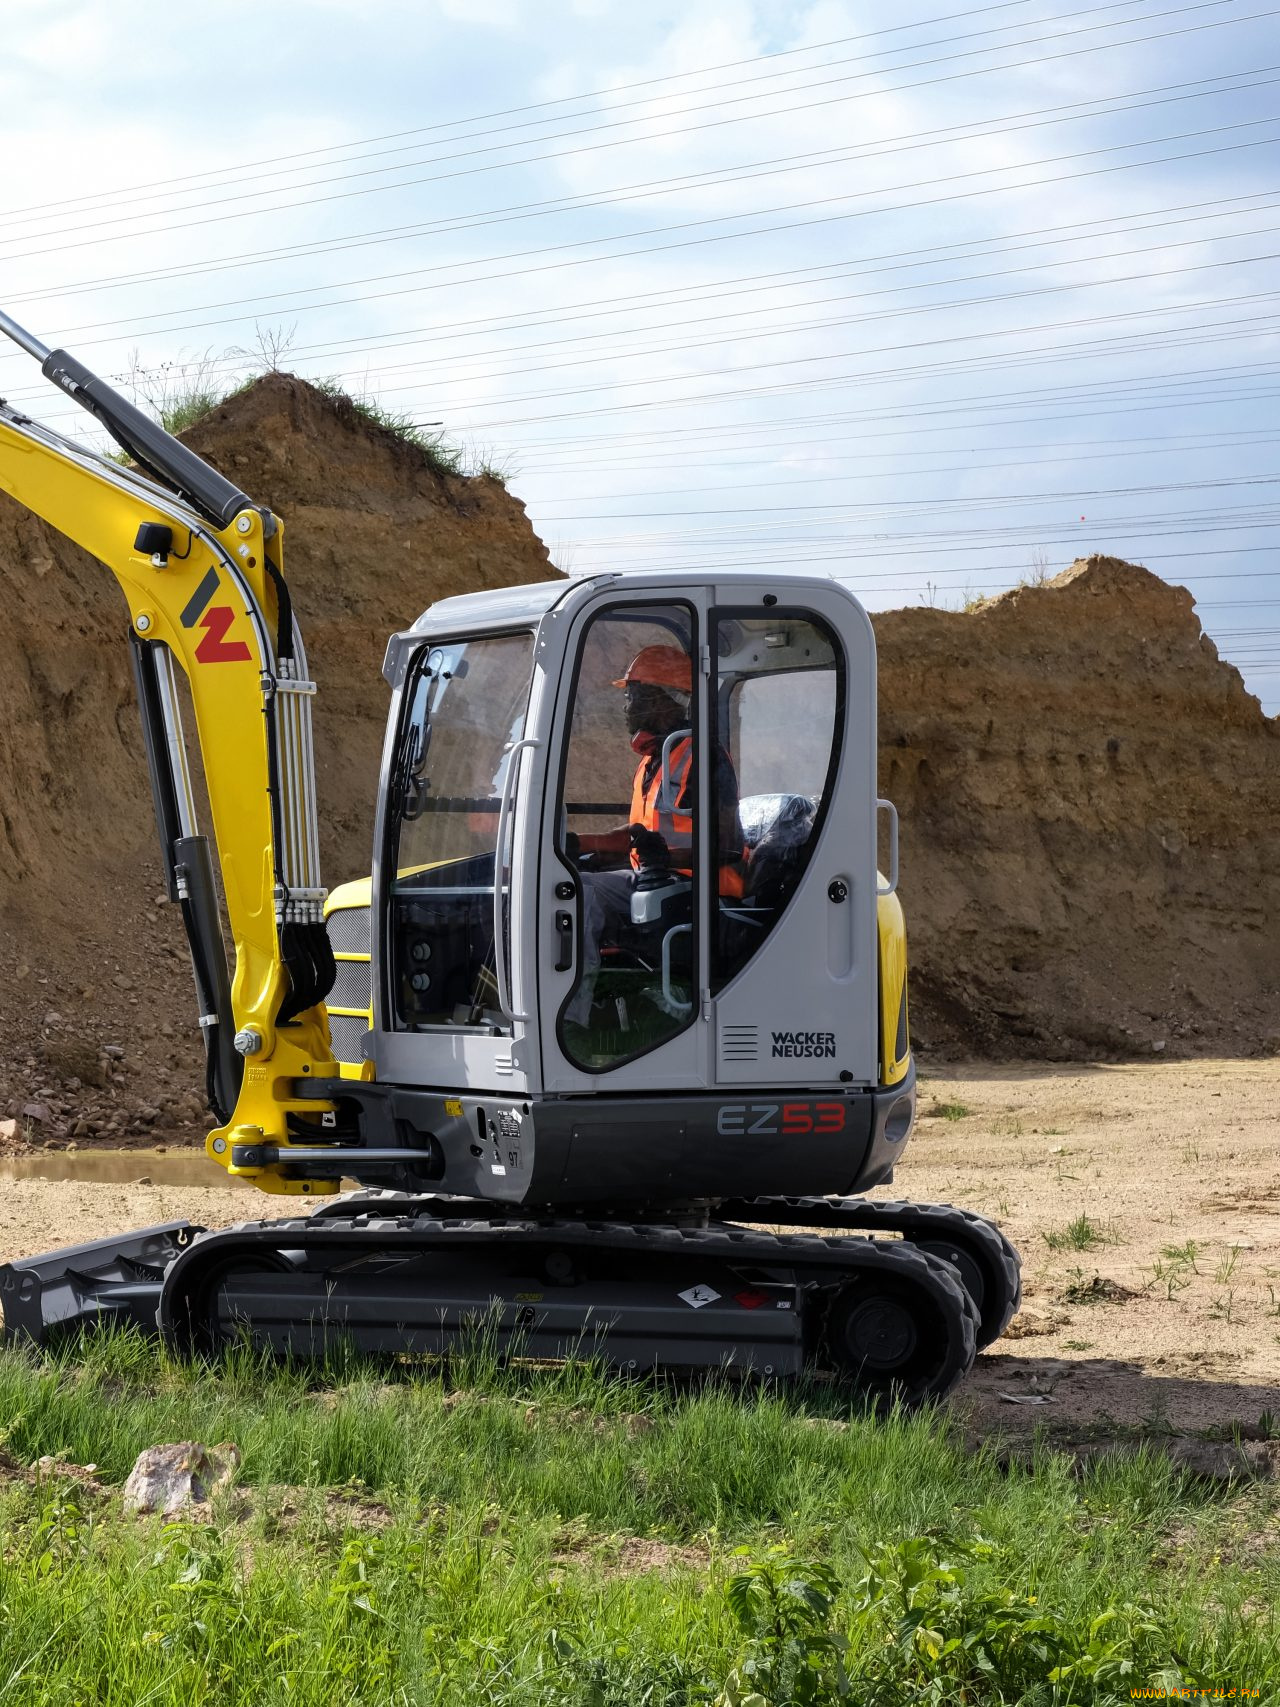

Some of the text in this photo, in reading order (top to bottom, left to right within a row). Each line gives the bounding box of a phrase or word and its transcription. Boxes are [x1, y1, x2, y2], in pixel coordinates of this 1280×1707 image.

[770, 1031, 836, 1045] WACKER
[771, 1045, 836, 1058] NEUSON
[717, 1103, 846, 1135] EZ53
